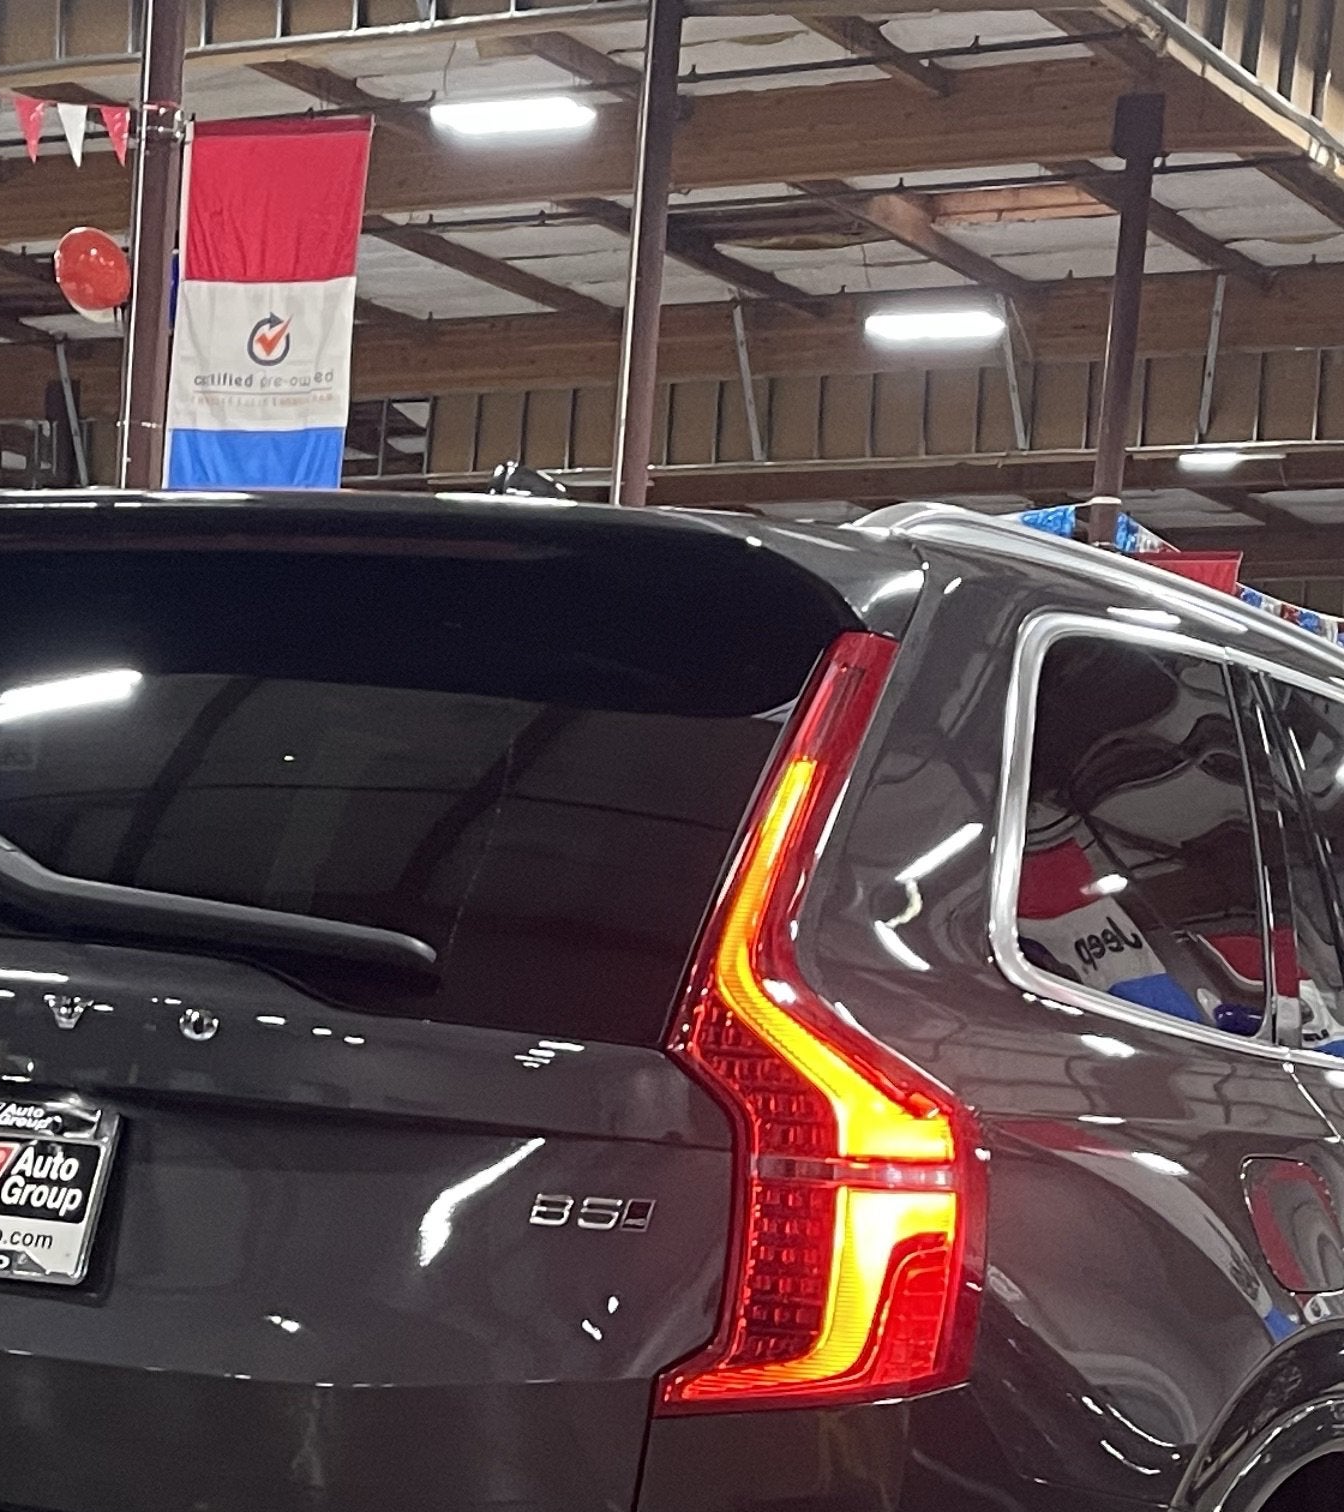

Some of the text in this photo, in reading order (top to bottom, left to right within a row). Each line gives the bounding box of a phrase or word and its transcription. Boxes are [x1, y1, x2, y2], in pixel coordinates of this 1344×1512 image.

[7, 1103, 45, 1118] Auto
[11, 1144, 80, 1182] Auto
[1, 1175, 83, 1217] Group
